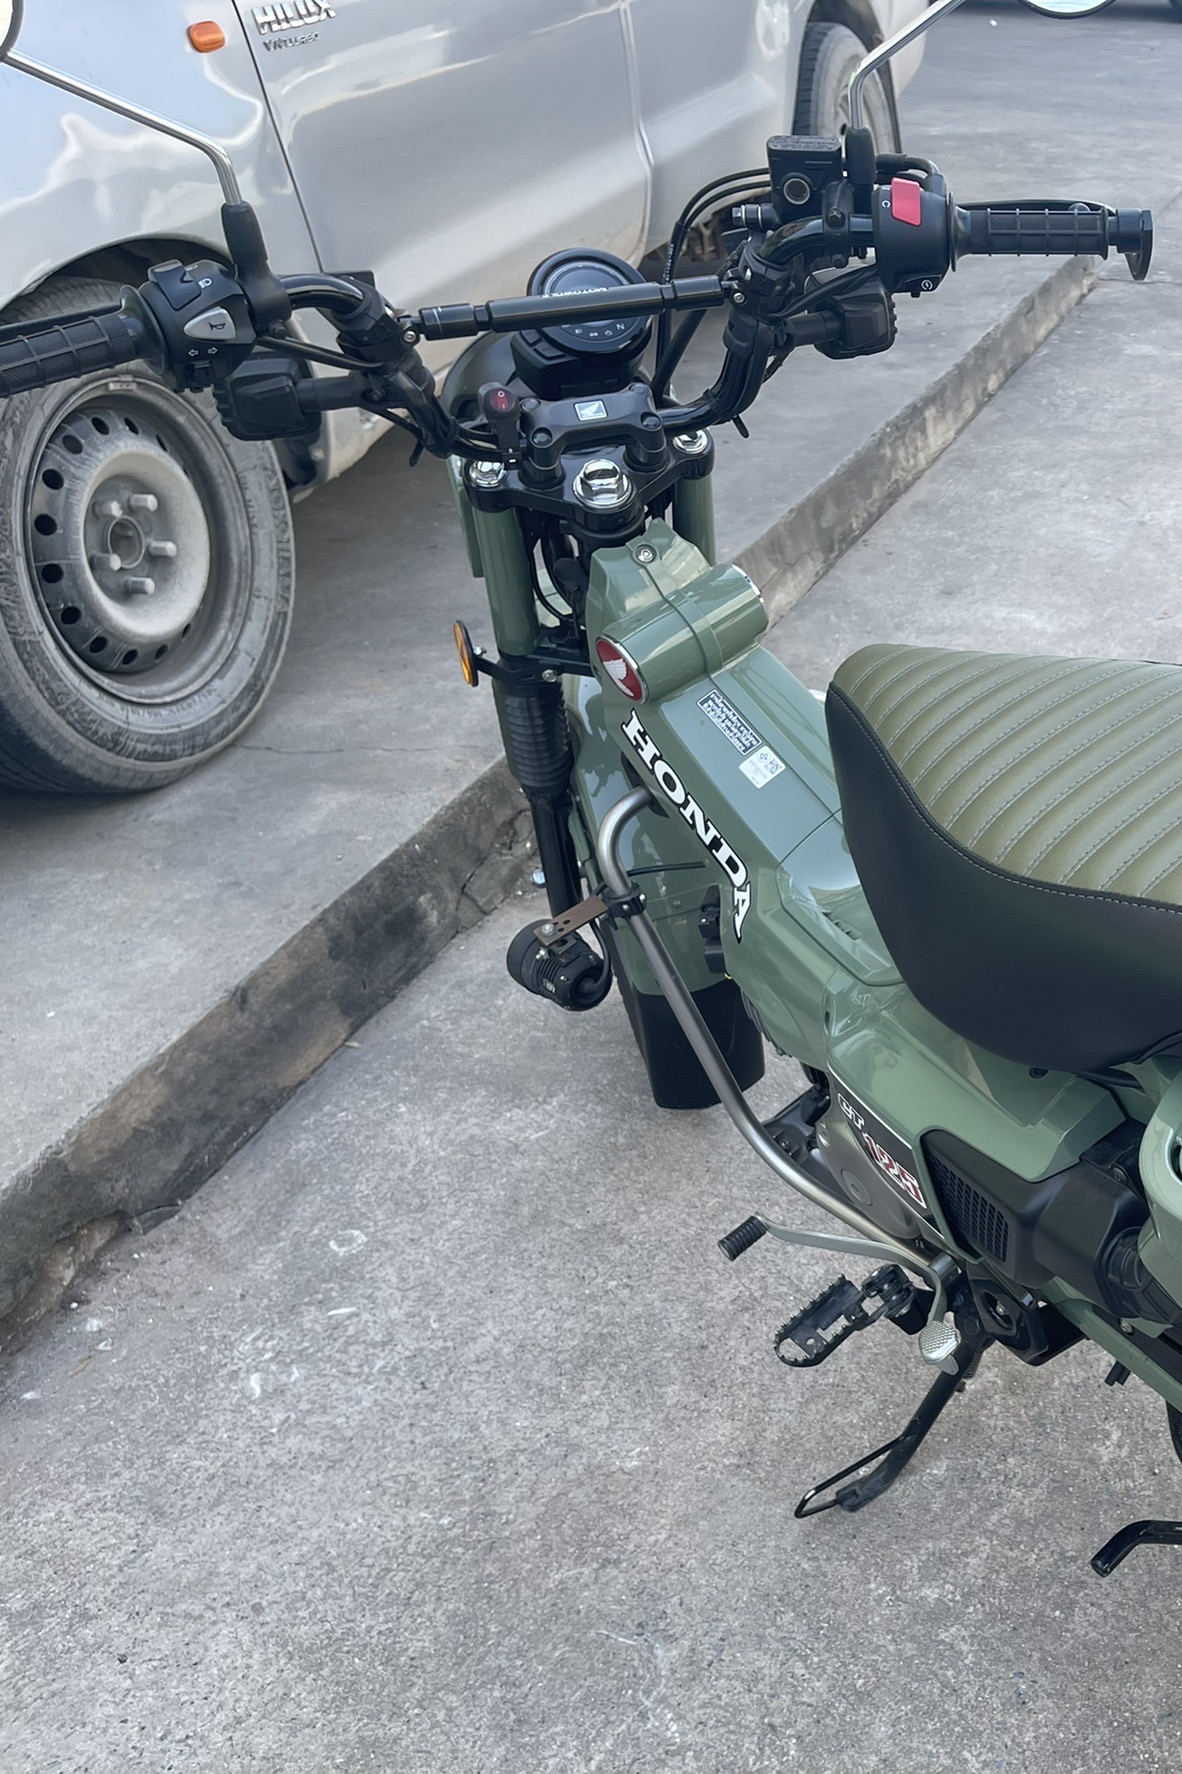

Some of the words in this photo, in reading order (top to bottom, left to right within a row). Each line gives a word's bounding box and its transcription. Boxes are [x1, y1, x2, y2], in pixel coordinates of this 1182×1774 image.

[251, 0, 336, 35] HILUX
[616, 322, 626, 331] N
[620, 706, 753, 944] HONDA
[837, 1093, 866, 1130] CT
[862, 1132, 928, 1210] 125
